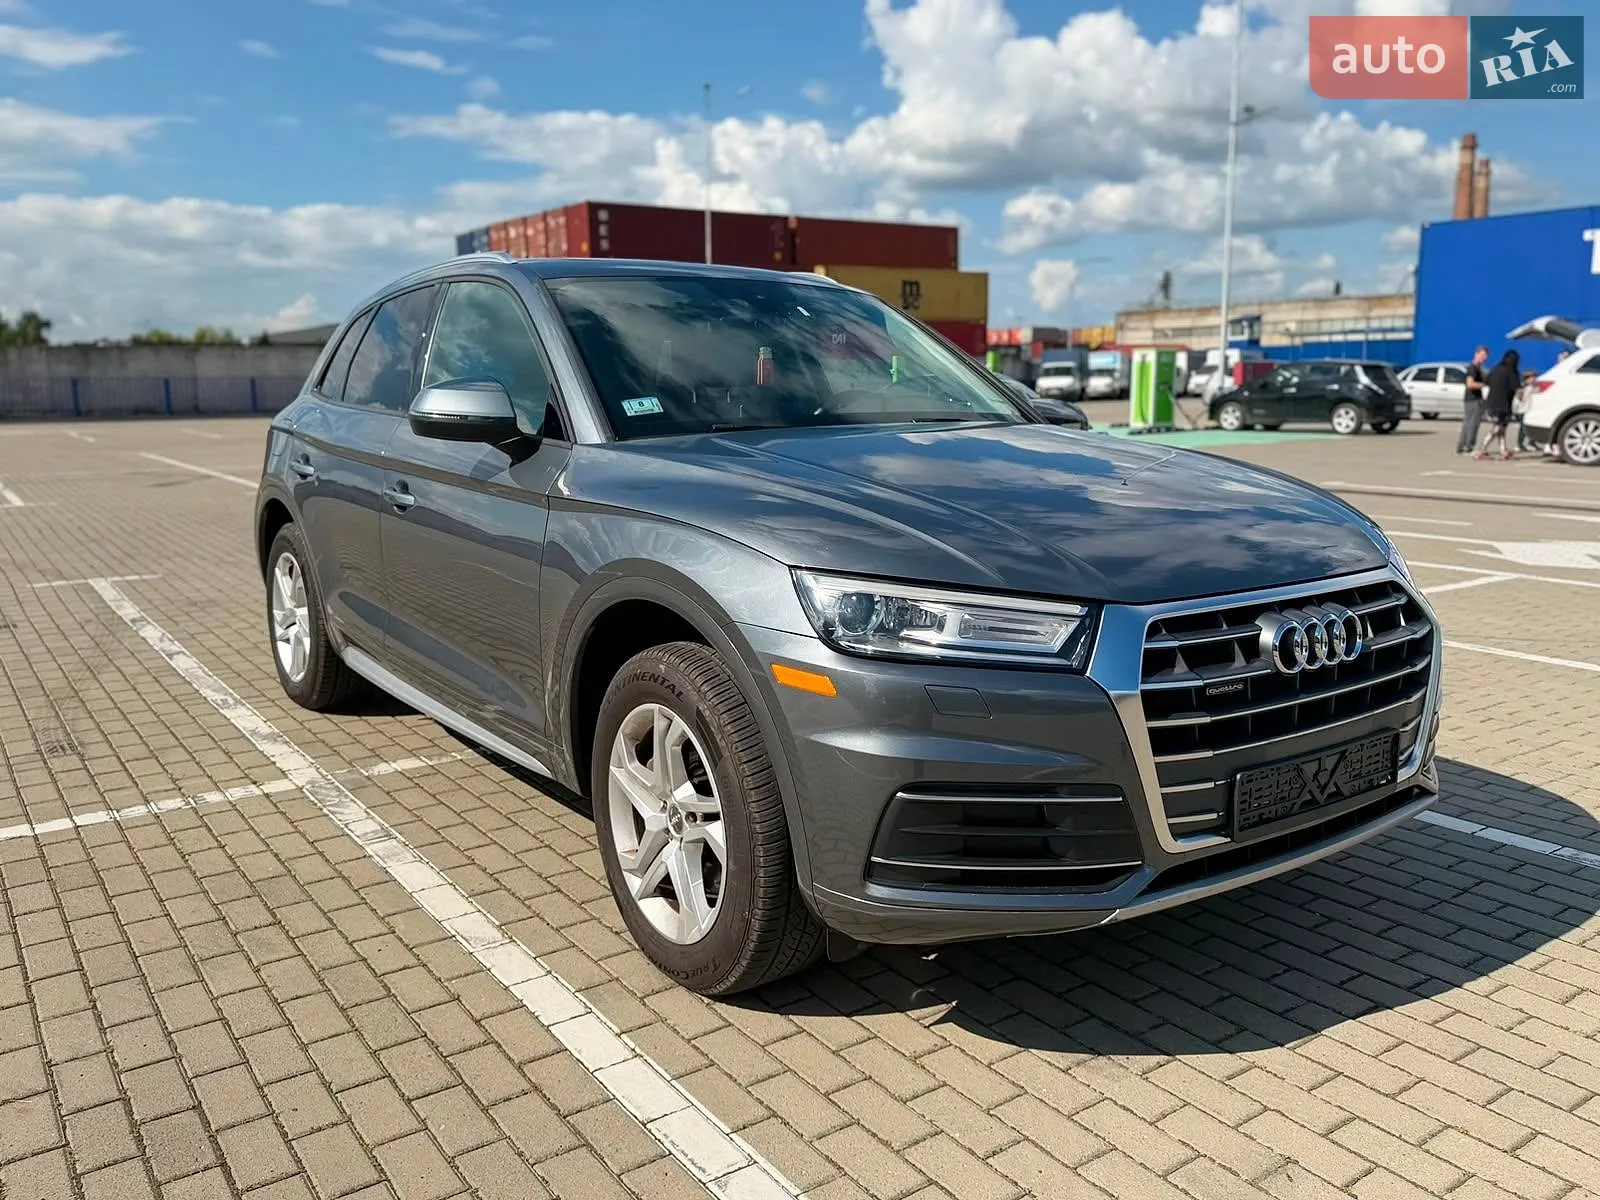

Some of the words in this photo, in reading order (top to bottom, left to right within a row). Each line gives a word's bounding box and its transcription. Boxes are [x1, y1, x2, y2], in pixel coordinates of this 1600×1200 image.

[602, 671, 684, 714] ONTINENTAL
[1208, 683, 1245, 694] quattro
[647, 953, 721, 980] TRUECON
